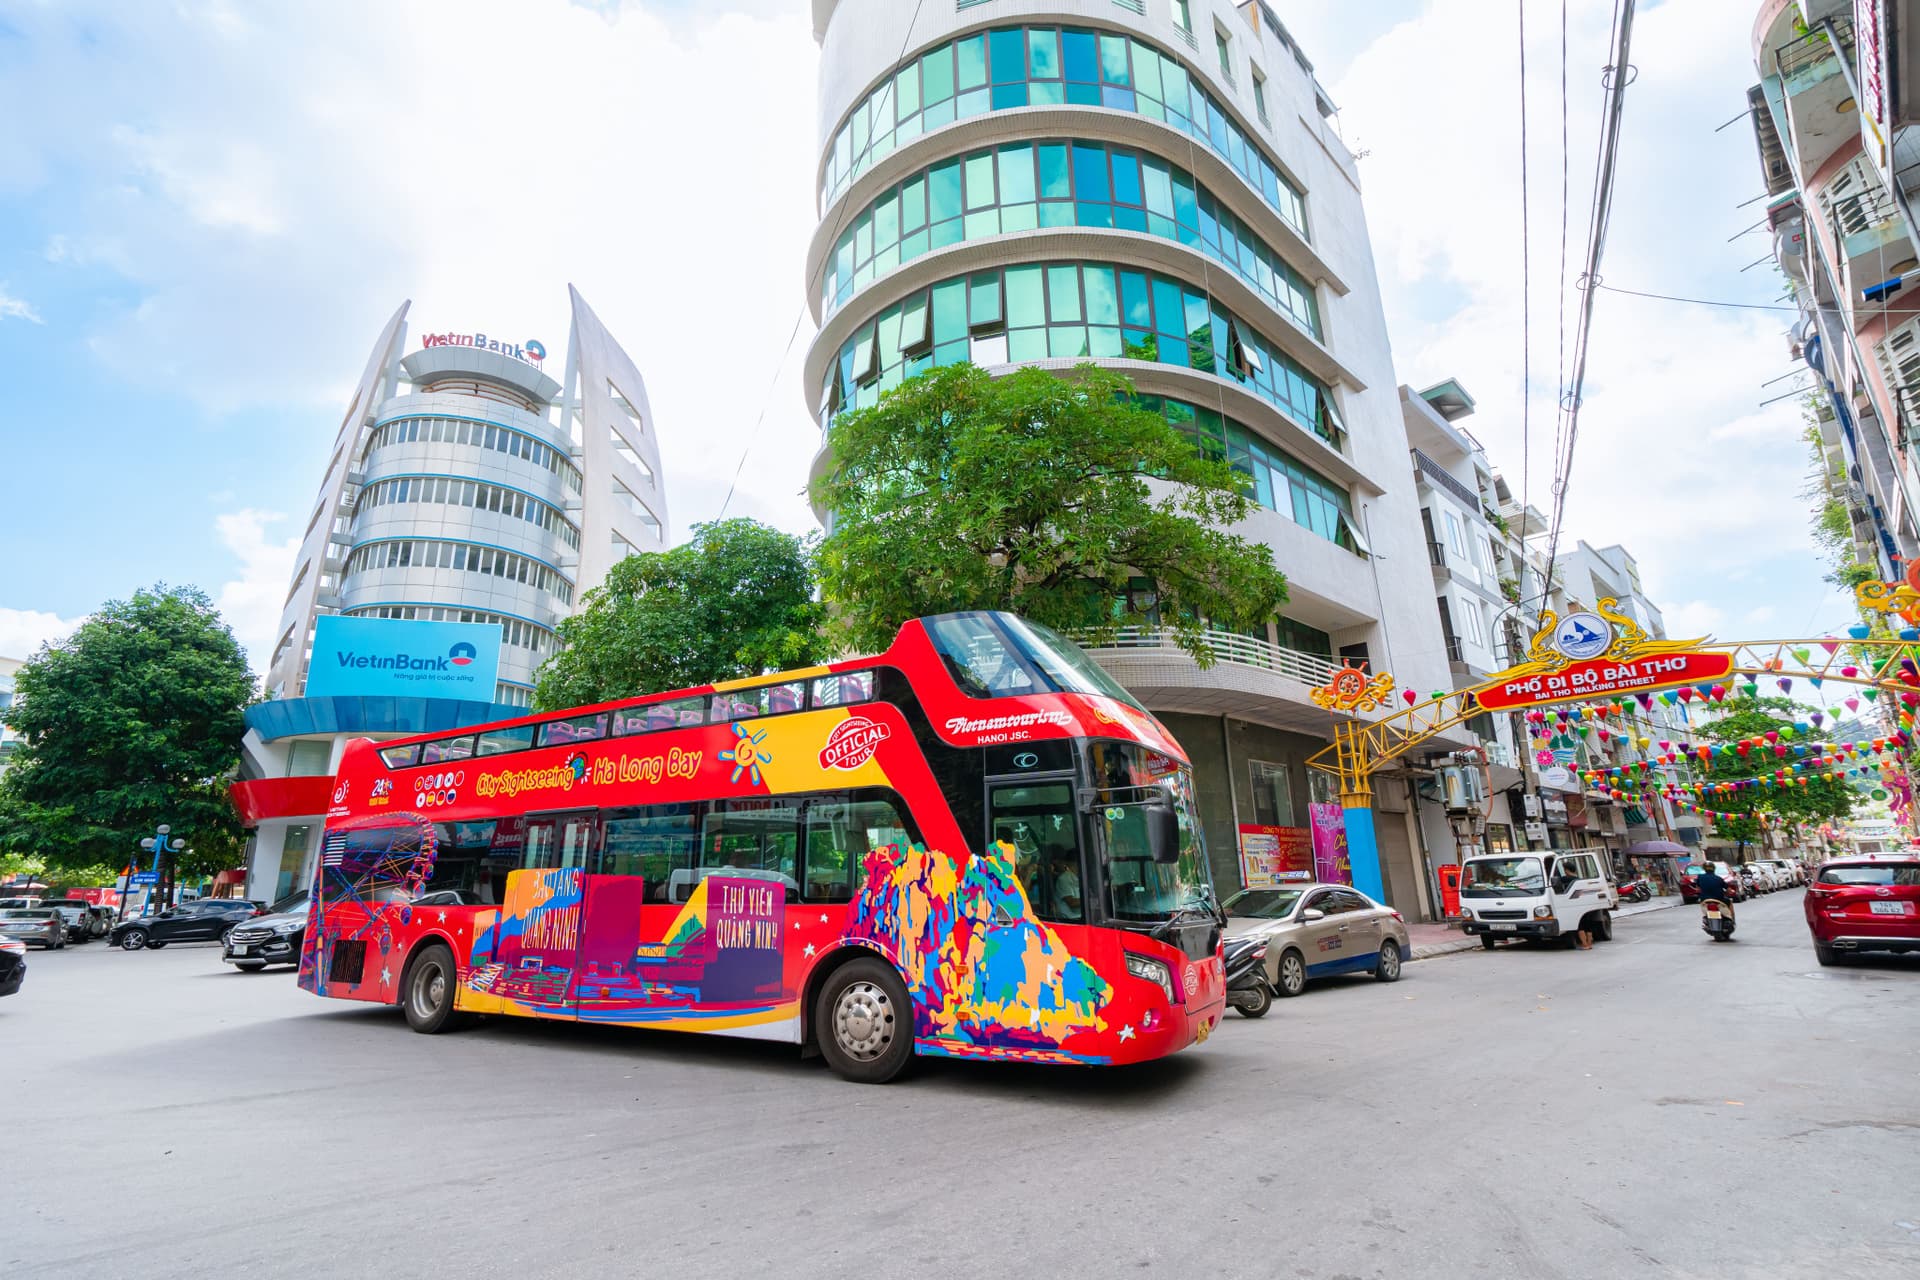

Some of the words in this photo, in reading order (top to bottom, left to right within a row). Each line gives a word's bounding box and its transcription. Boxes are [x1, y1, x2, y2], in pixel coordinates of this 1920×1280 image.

[422, 332, 526, 360] VietinBank
[337, 651, 449, 671] VietinBank
[1505, 675, 1542, 696] PHỐ
[1547, 675, 1567, 689] ĐI
[1571, 668, 1599, 686] BỘ
[1603, 663, 1638, 681] BÀI
[1641, 656, 1687, 675] THƠ
[1535, 692, 1550, 700] BAI
[1552, 688, 1571, 697] THO
[1573, 681, 1616, 694] WALKING
[1618, 675, 1656, 688] STREET
[825, 726, 886, 763] OFFICIAL
[977, 733, 1007, 745] HANOI
[1010, 730, 1032, 741] JSC.
[593, 757, 616, 785] Ha
[619, 754, 664, 784] Long
[667, 747, 703, 778] Bay
[845, 747, 873, 767] TOUR
